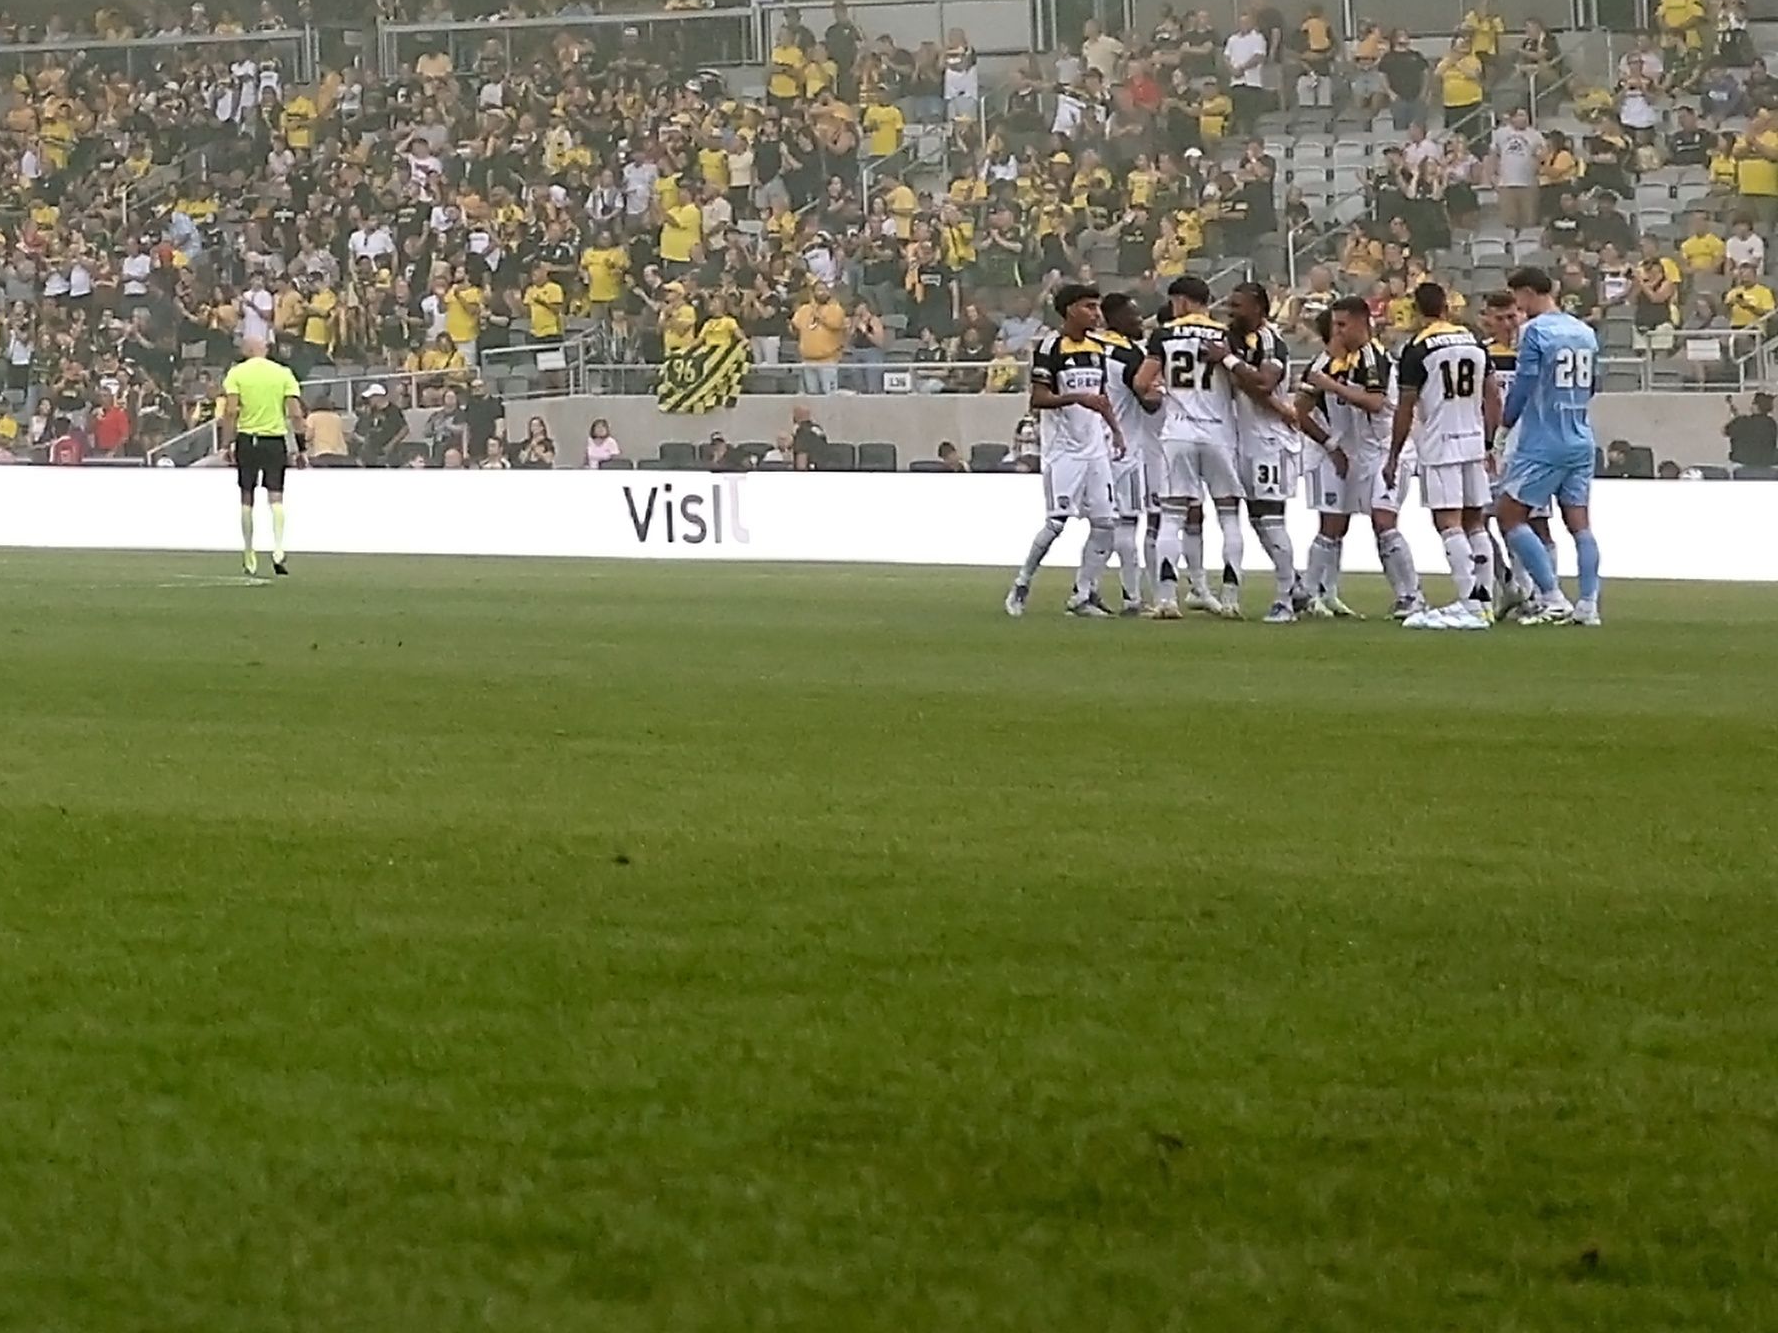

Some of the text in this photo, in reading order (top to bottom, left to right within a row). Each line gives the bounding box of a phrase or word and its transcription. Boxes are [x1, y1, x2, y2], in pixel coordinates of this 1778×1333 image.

[671, 358, 696, 384] 96
[1171, 349, 1216, 389] 27
[1439, 357, 1477, 400] 18
[1554, 347, 1593, 388] 28
[1257, 464, 1279, 483] 31
